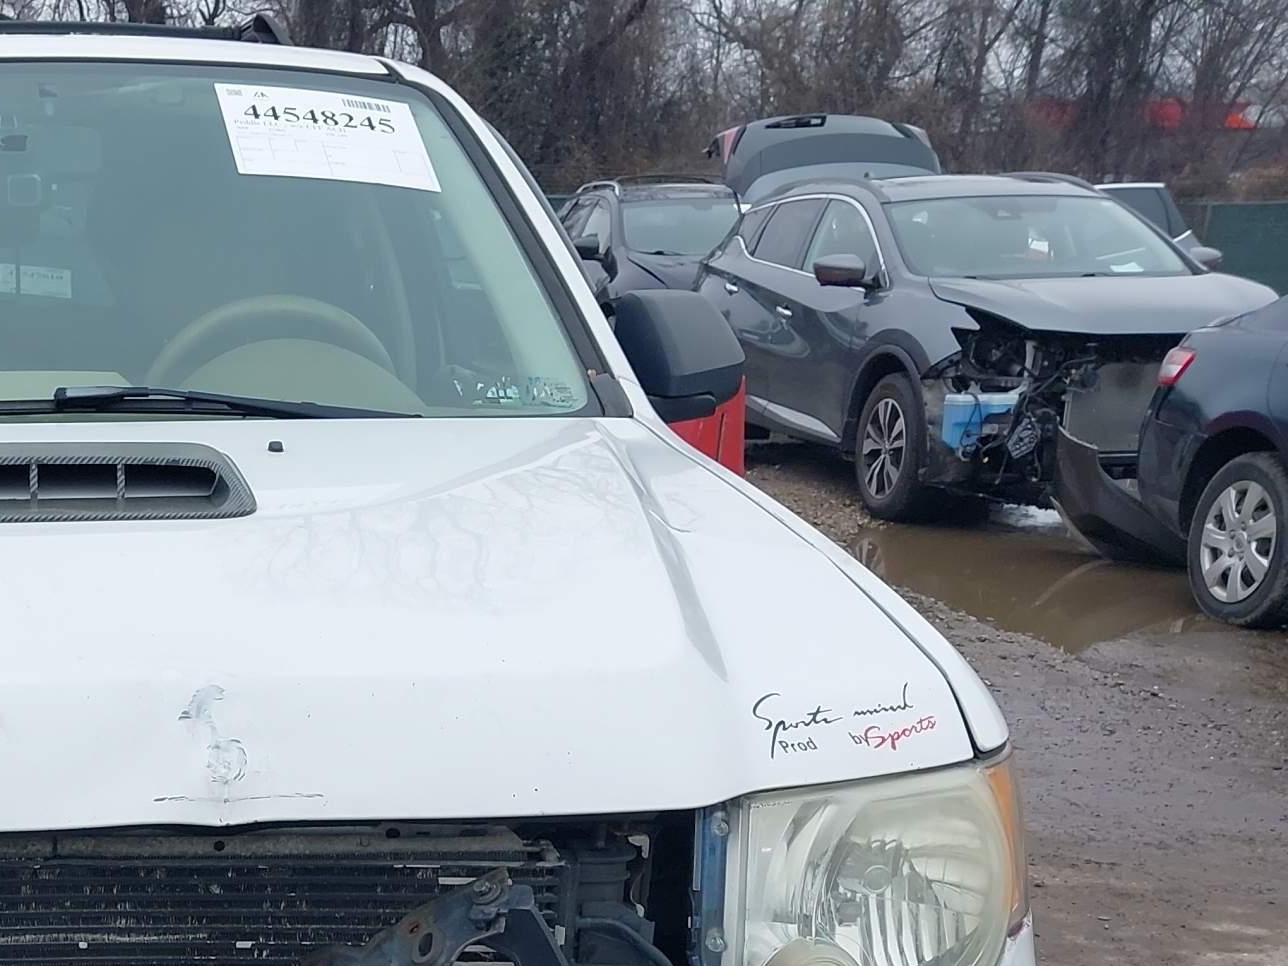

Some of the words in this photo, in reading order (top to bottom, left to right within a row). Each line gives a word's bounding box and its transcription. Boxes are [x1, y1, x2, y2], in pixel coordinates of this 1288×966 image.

[244, 104, 395, 134] 44548245
[778, 736, 818, 754] Prod
[863, 715, 937, 751] Sports
